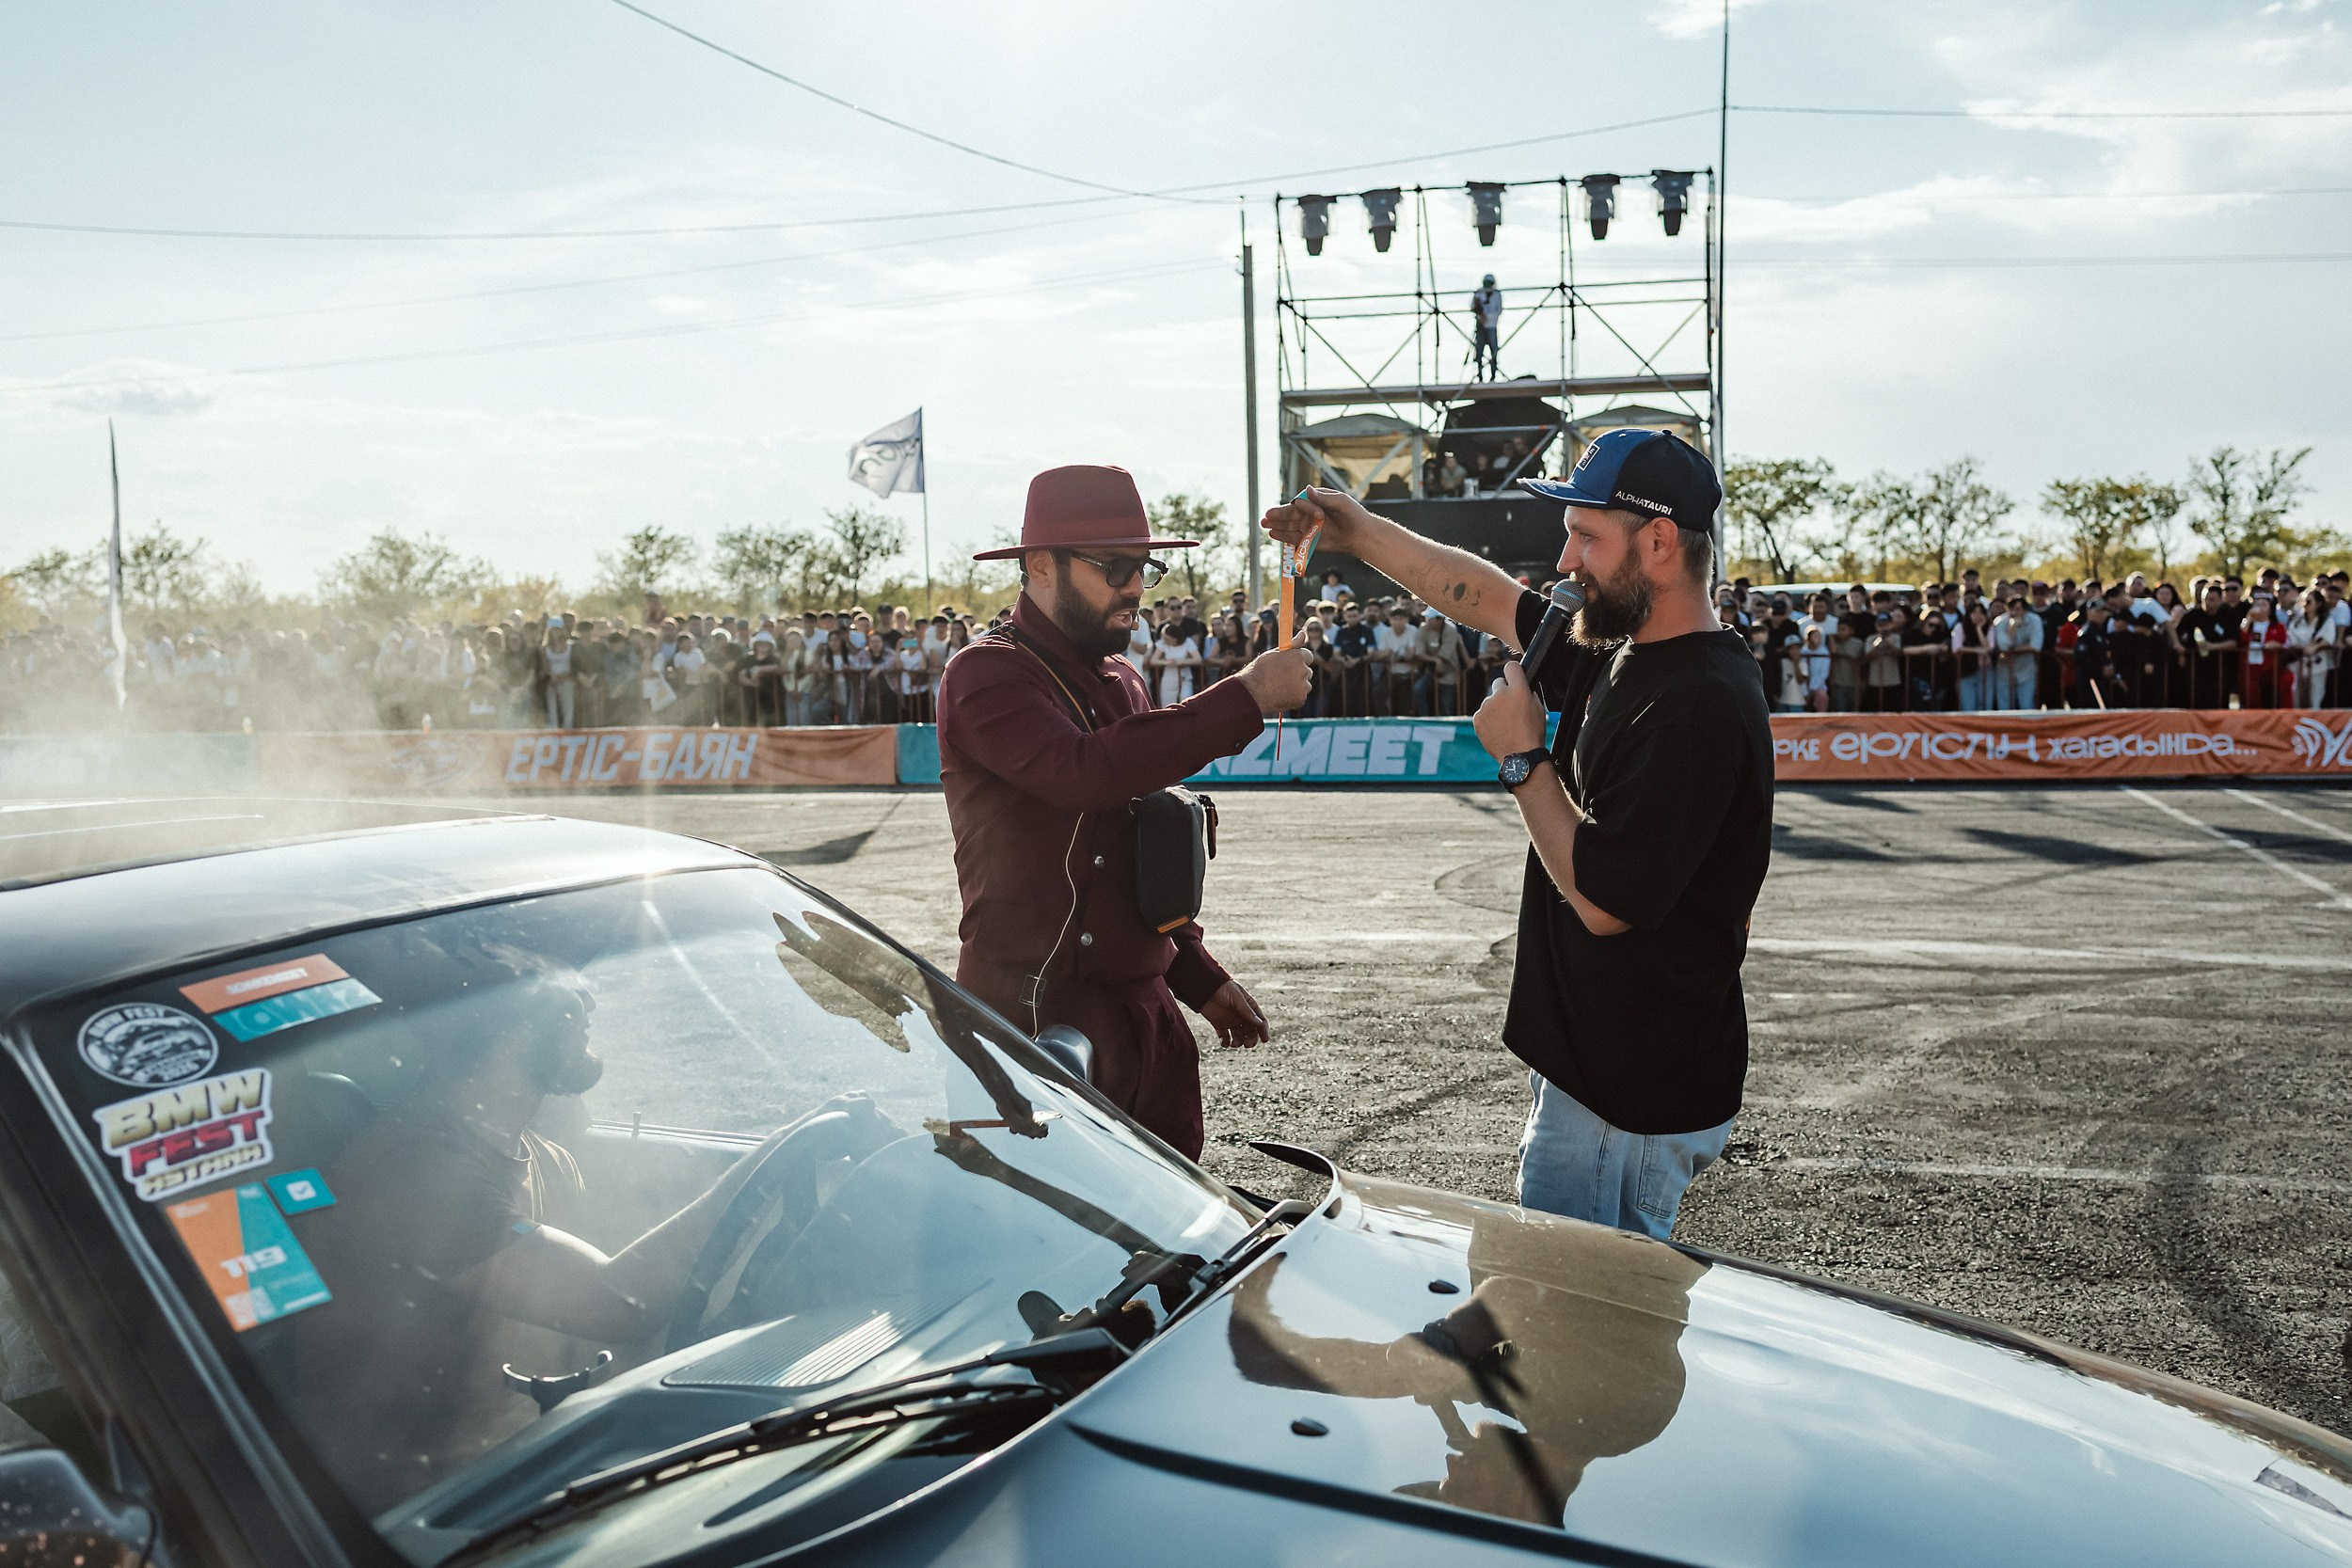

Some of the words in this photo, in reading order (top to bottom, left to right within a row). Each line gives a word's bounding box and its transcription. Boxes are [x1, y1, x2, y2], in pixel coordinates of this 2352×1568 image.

[1614, 490, 1673, 515] ALPHATAURI
[1194, 725, 1456, 776] ZMEET
[100, 1071, 266, 1149] BMW
[128, 1110, 266, 1178] FEST
[219, 1243, 288, 1279] 119
